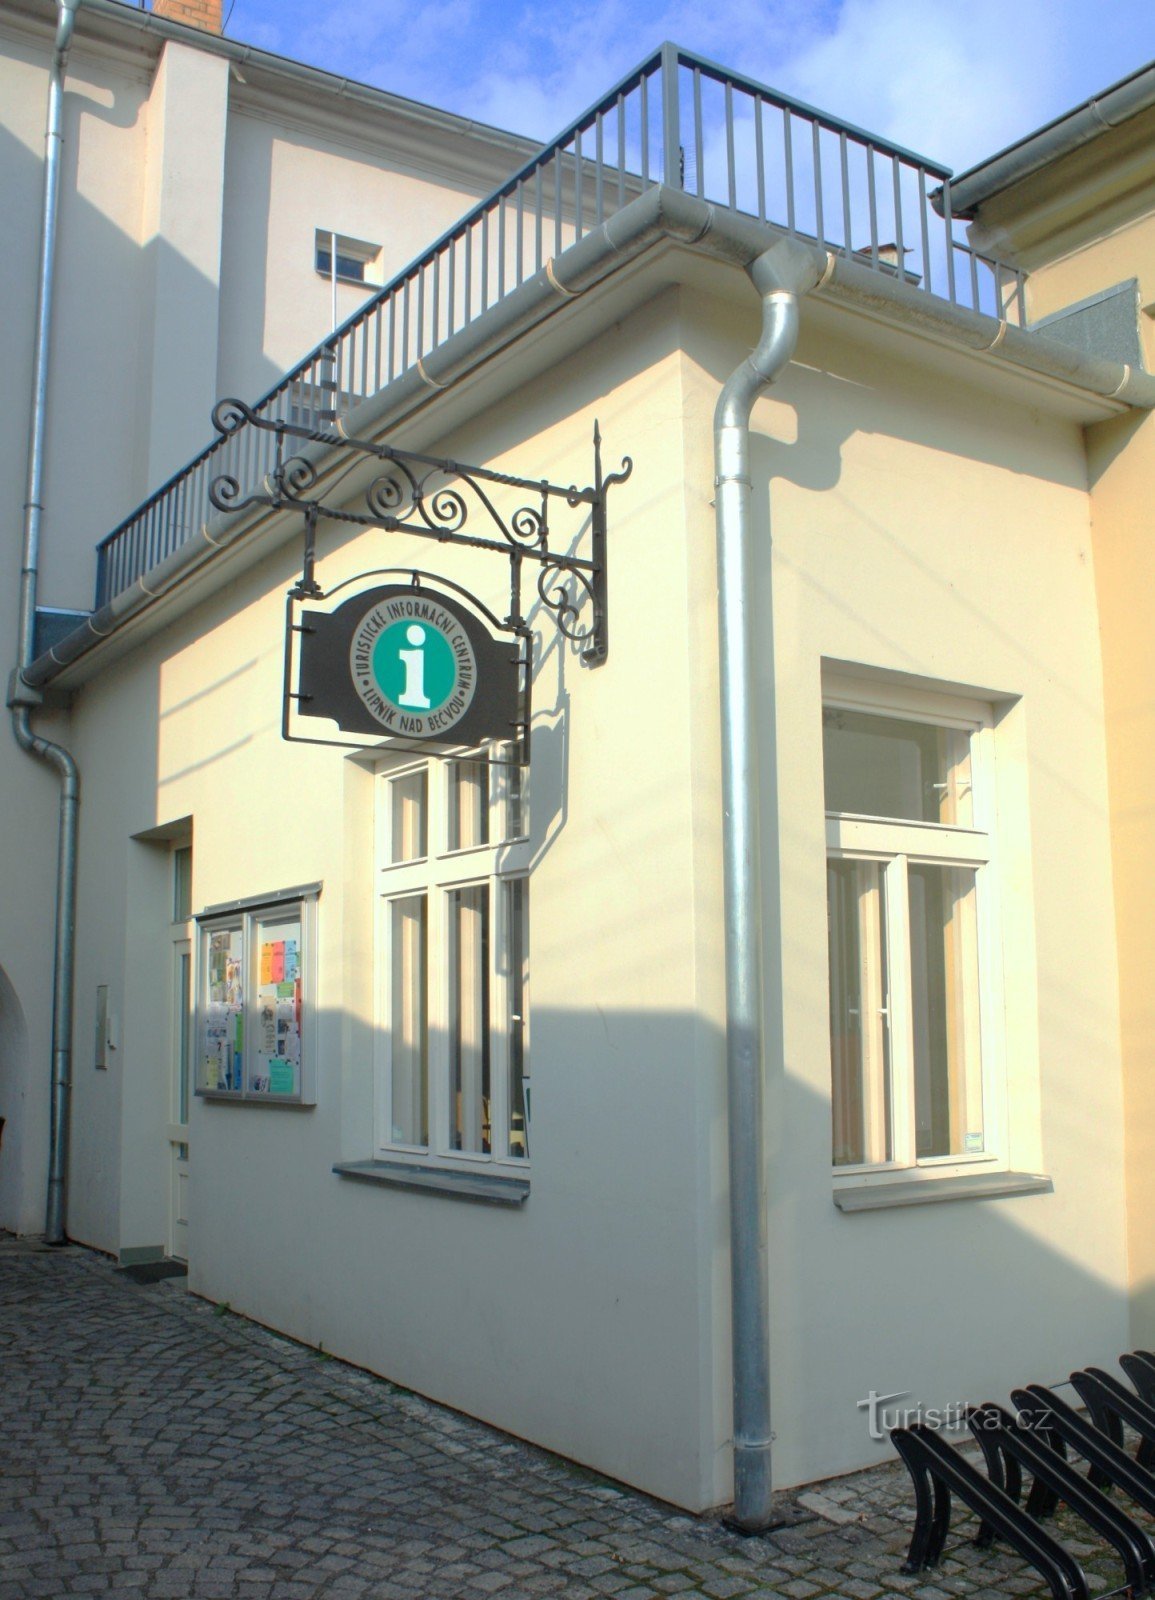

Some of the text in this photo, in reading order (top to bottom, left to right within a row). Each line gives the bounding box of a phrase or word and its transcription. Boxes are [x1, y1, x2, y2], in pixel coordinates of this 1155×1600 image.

[355, 601, 472, 689] TURISTICKÉ INFORMAČNÍ CENTRUM
[363, 688, 465, 733] LIPNÍK NAD BEČVOU
